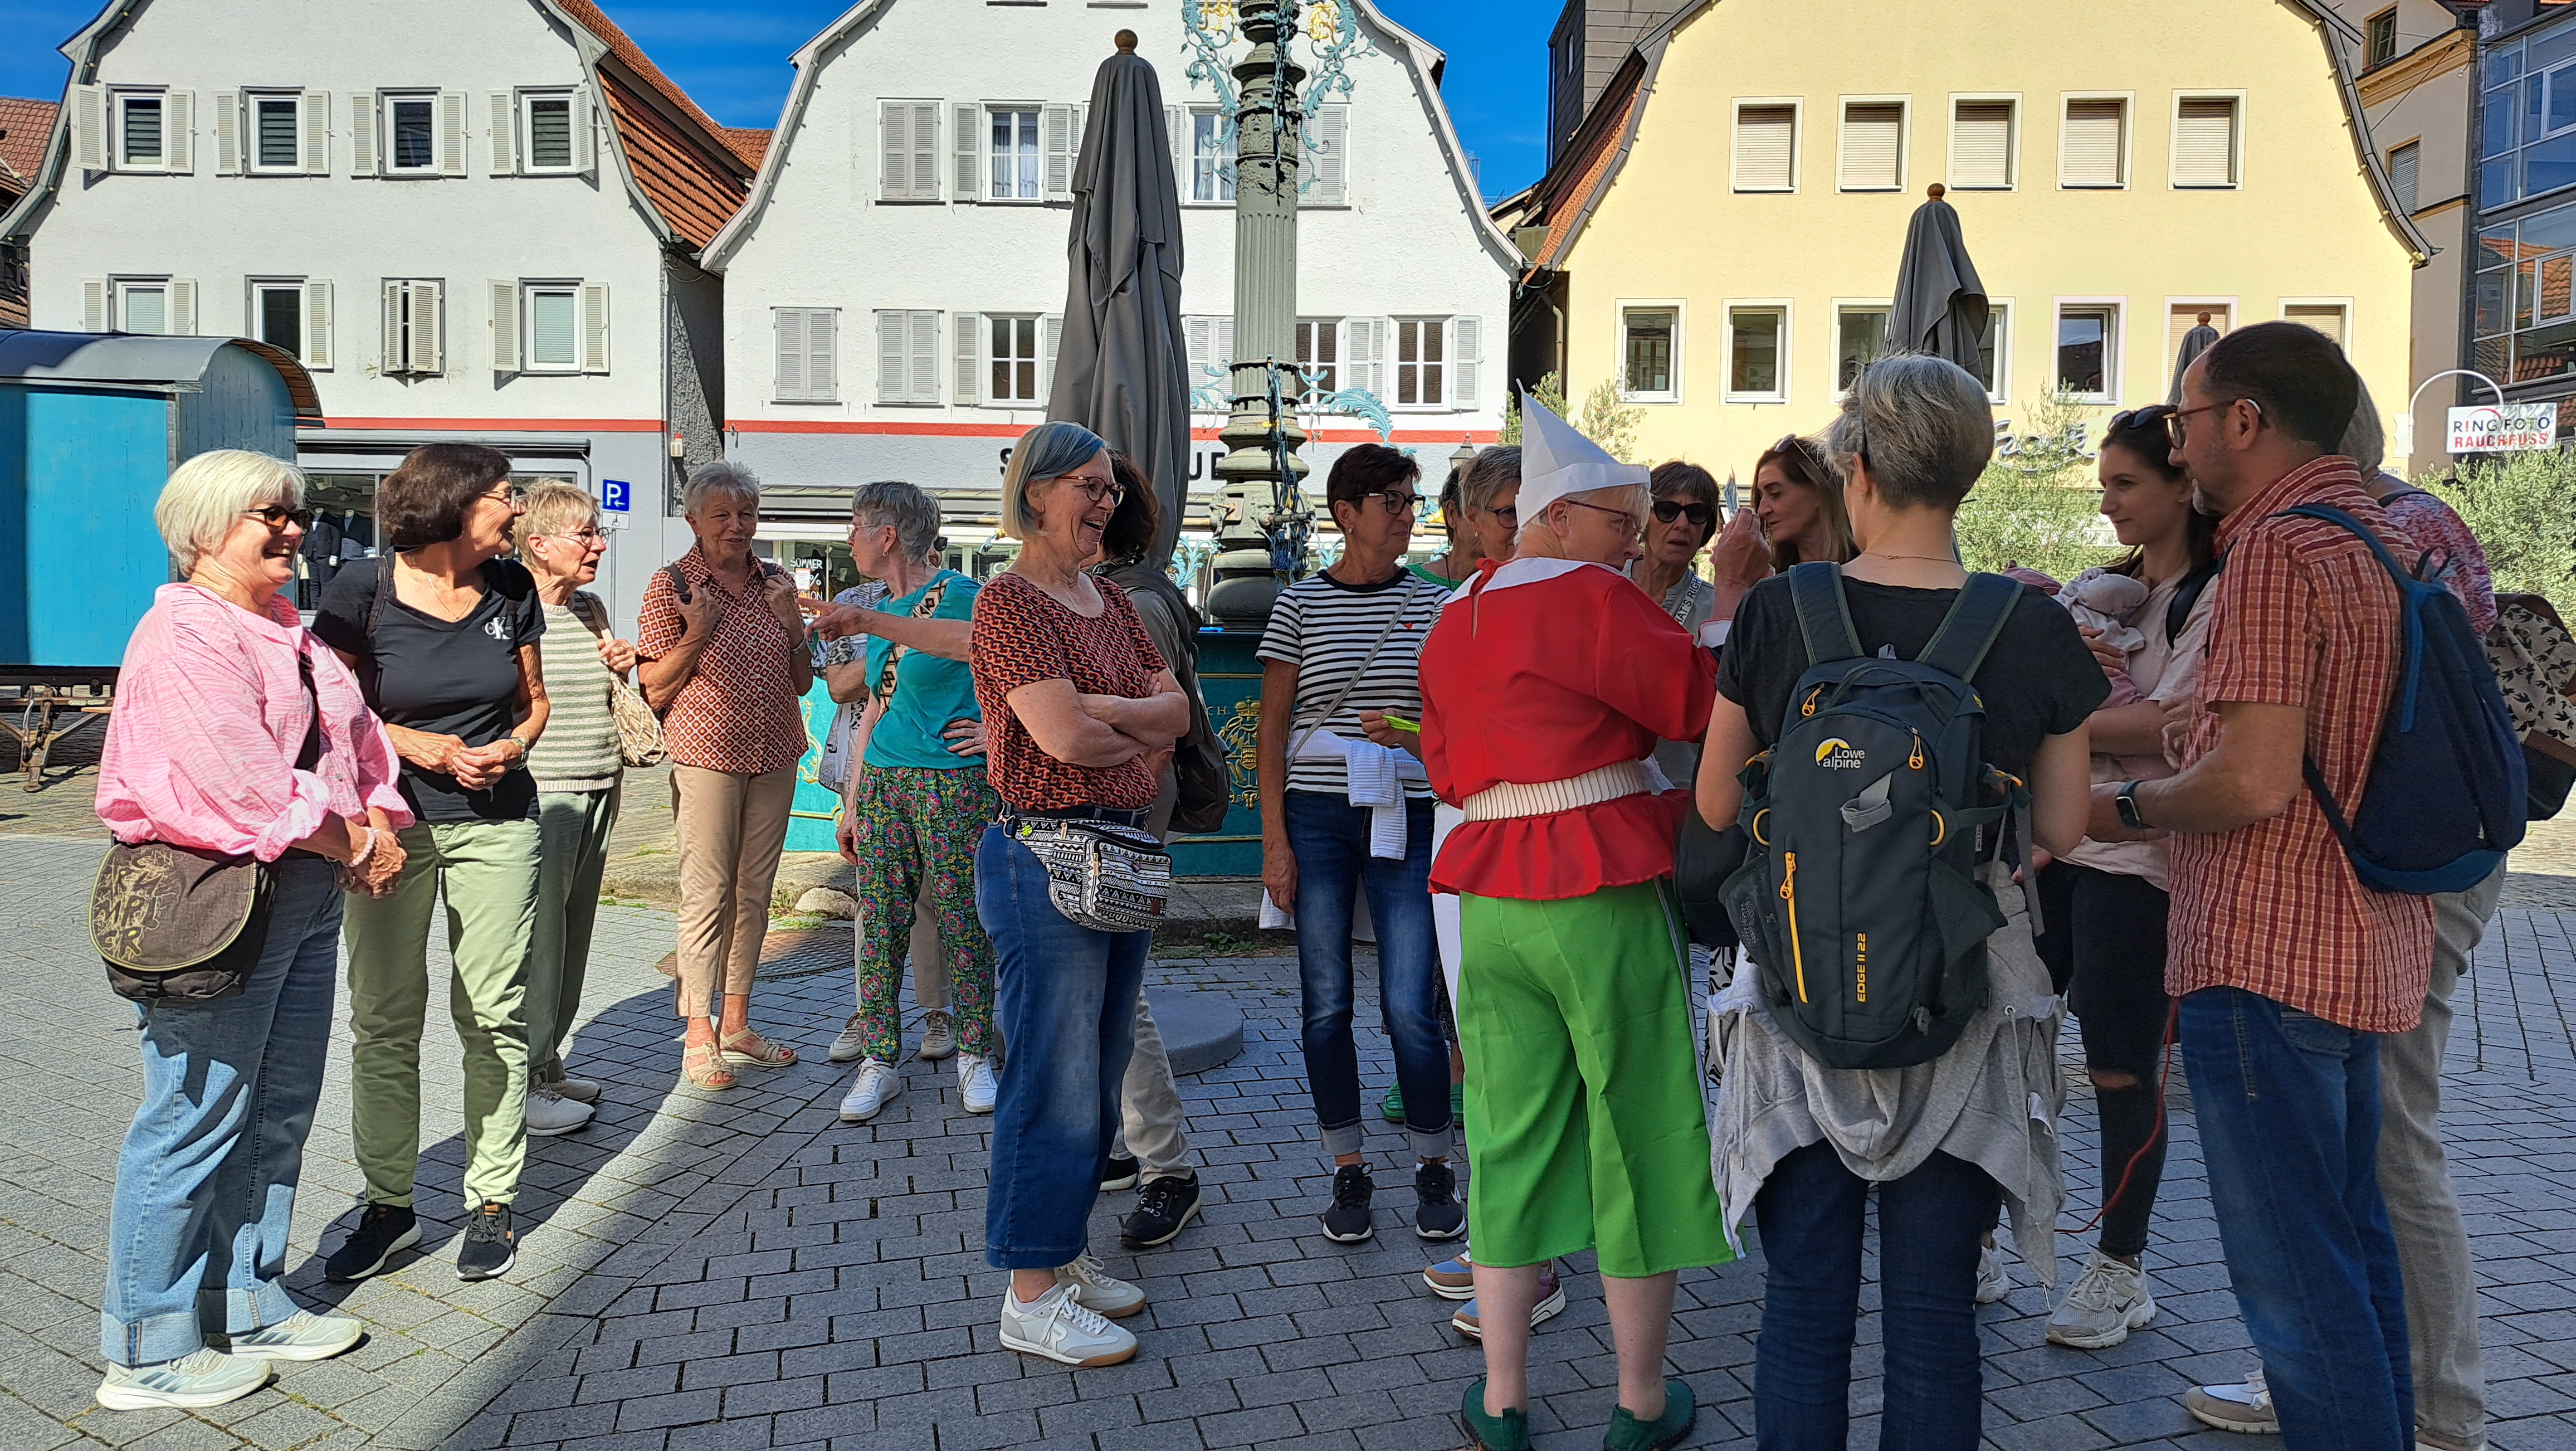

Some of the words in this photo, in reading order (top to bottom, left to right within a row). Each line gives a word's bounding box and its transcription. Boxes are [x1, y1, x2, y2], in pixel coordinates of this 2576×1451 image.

[2455, 433, 2549, 448] RAUCHFUSS
[606, 483, 622, 507] P
[789, 557, 823, 569] SOMMER
[1835, 747, 1866, 759] Lowe
[1822, 756, 1861, 771] alpine
[1857, 933, 1866, 952] 22
[1857, 964, 1866, 1002] EDGE
